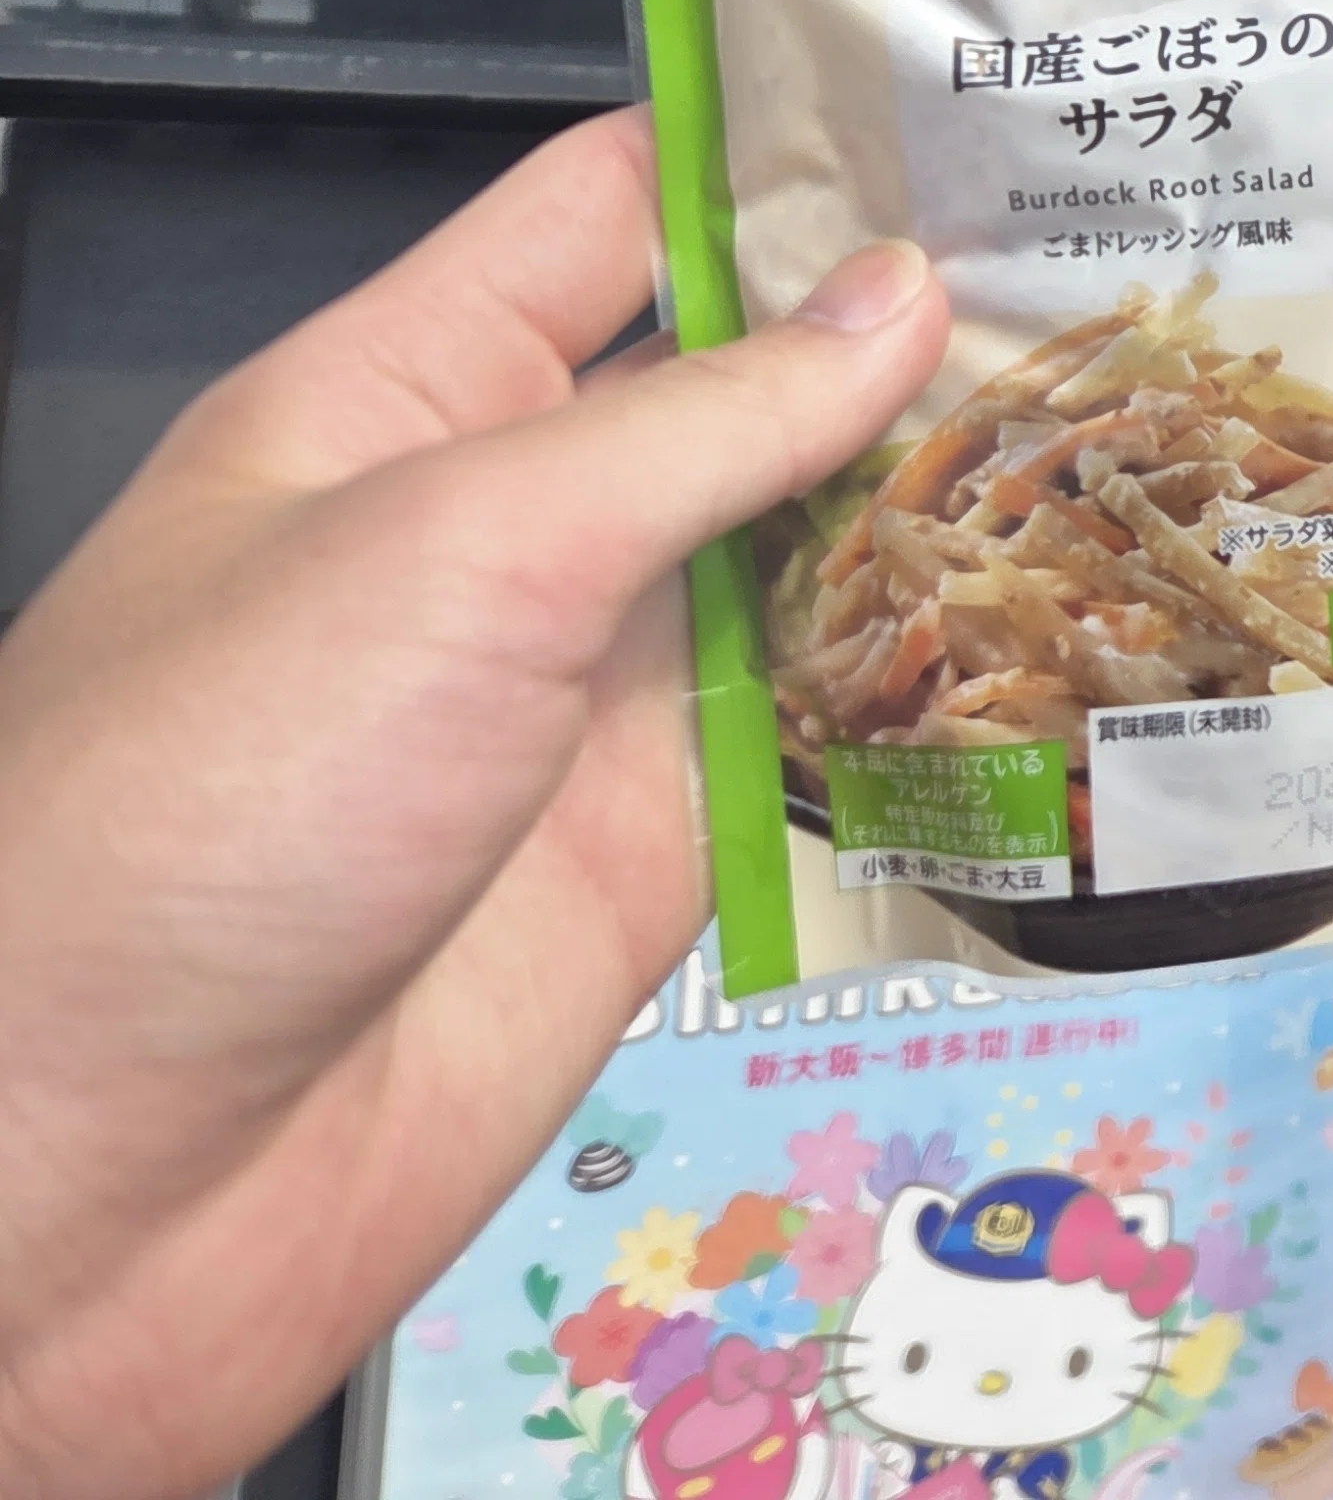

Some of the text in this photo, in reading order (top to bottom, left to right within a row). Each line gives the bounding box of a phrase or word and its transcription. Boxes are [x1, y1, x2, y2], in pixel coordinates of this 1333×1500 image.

[1059, 79, 1243, 155] サラダ
[1008, 164, 1314, 212] Burdock Root Salad
[1043, 216, 1293, 259] ごまドレッシング風味
